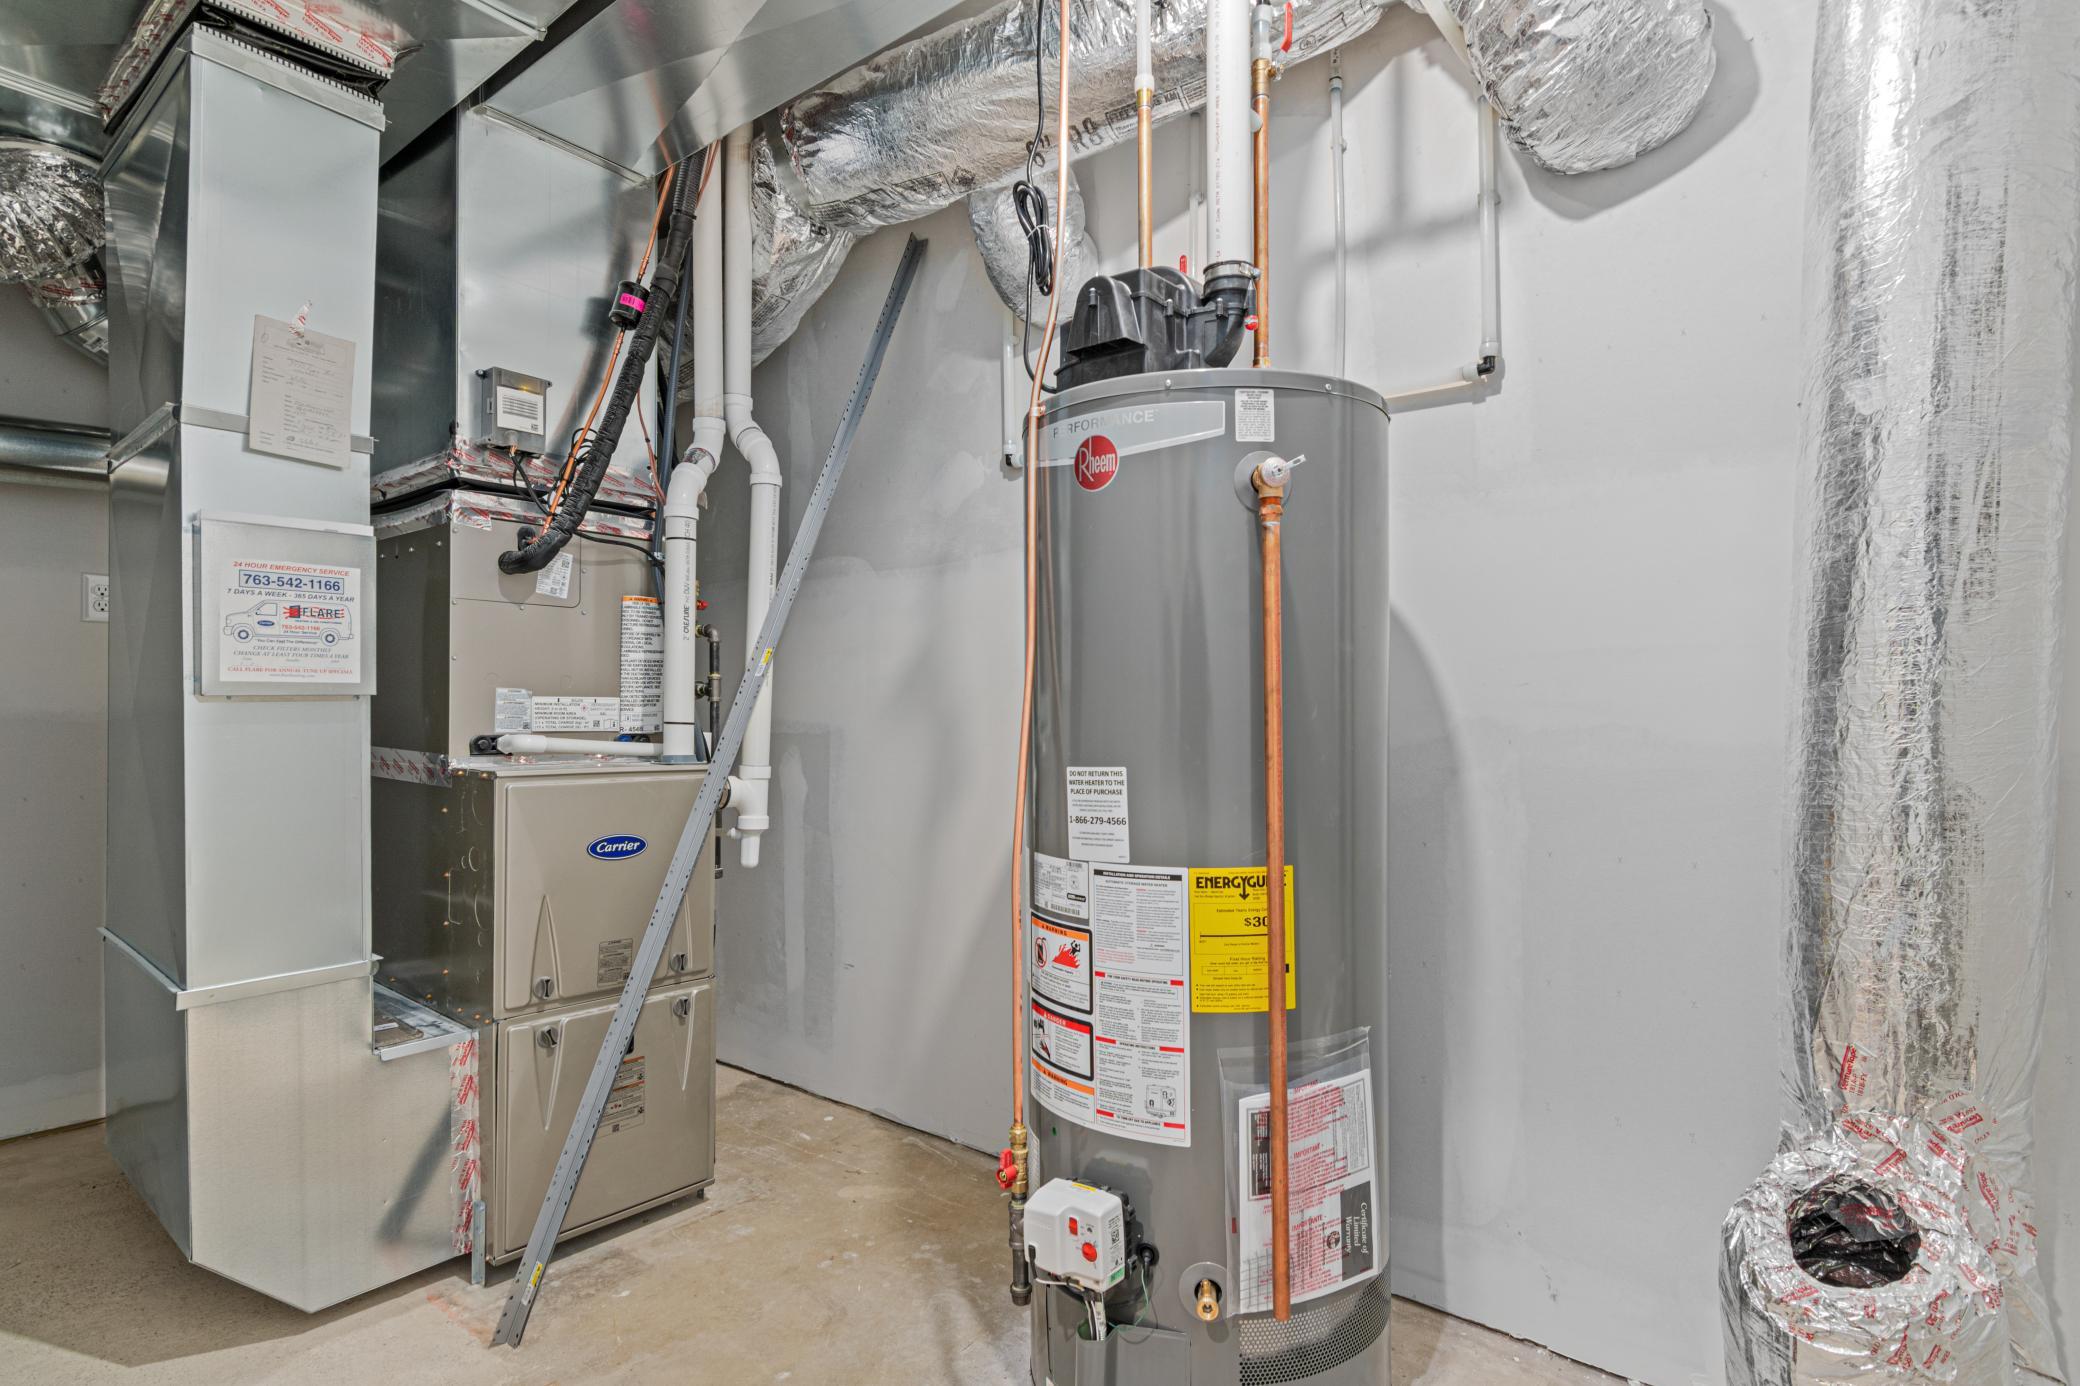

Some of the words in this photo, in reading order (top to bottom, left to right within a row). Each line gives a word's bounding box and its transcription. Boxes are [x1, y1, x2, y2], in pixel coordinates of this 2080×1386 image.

[1080, 437, 1116, 481] Rheem
[270, 564, 318, 573] EMERGENCY
[319, 568, 350, 576] SERVICE
[244, 574, 340, 592] 763-542-1166
[265, 590, 287, 598] WEEK
[302, 608, 341, 618] FLARE
[1070, 816, 1126, 825] 1-866-279-4566
[597, 841, 640, 852] Carrier
[1046, 925, 1067, 936] WARNING
[1047, 1014, 1066, 1026] DANGER
[1048, 1070, 1068, 1086] WARNING
[1294, 1143, 1320, 1159] IMPORTANT
[1360, 1202, 1368, 1244] Certificate
[1344, 1216, 1352, 1253] Warranty
[1353, 1216, 1361, 1246] Limited
[1361, 1245, 1368, 1254] of
